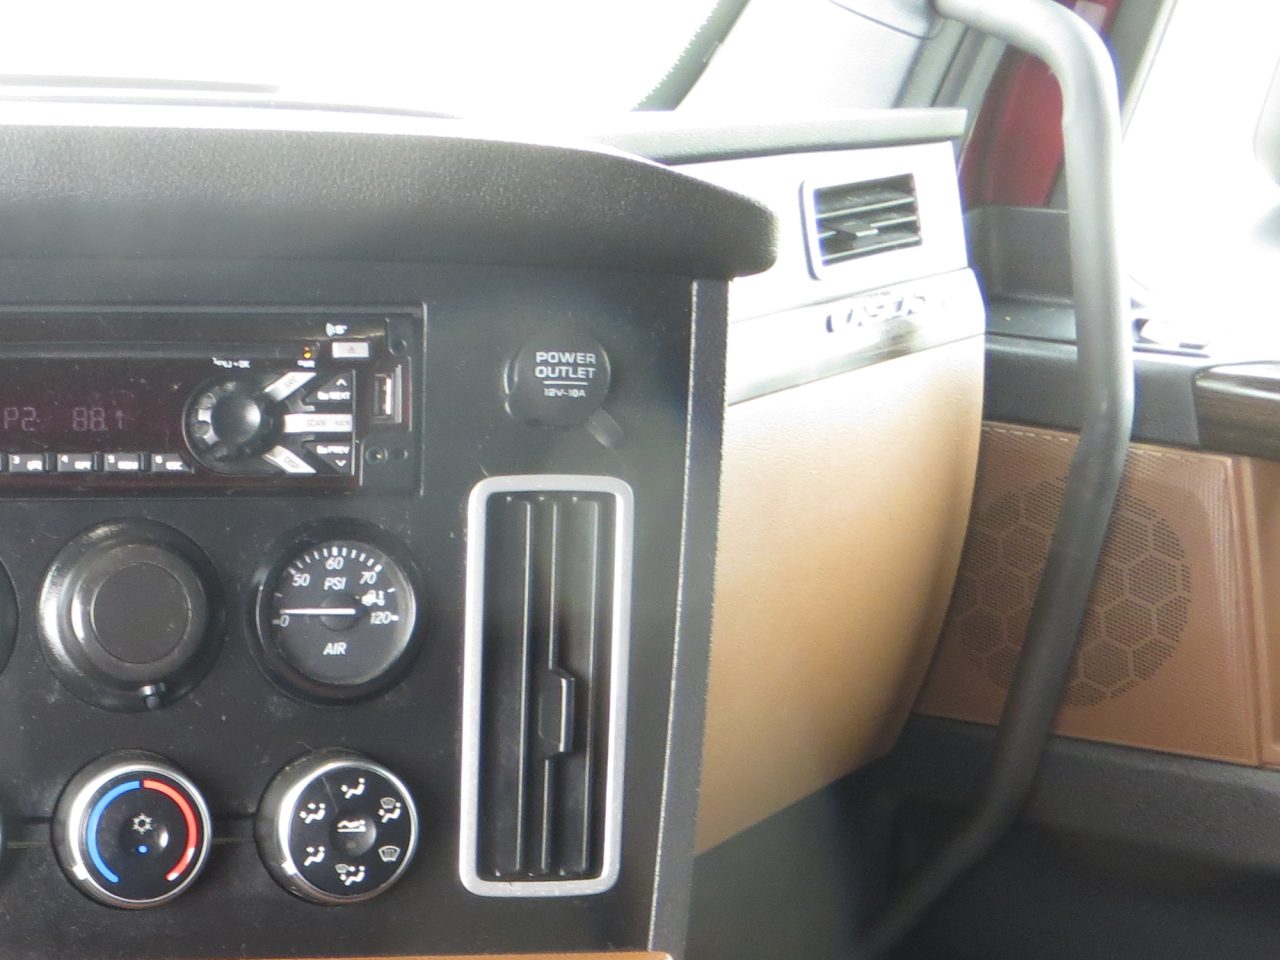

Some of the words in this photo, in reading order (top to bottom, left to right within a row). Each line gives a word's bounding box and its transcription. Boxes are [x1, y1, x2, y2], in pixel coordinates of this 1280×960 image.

[535, 351, 596, 364] POWER
[535, 365, 597, 379] OUTLET
[325, 556, 344, 571] 60
[291, 573, 311, 587] 50
[323, 577, 347, 591] PSI
[359, 571, 377, 585] 70
[370, 610, 392, 625] 120
[322, 641, 347, 656] AIR
